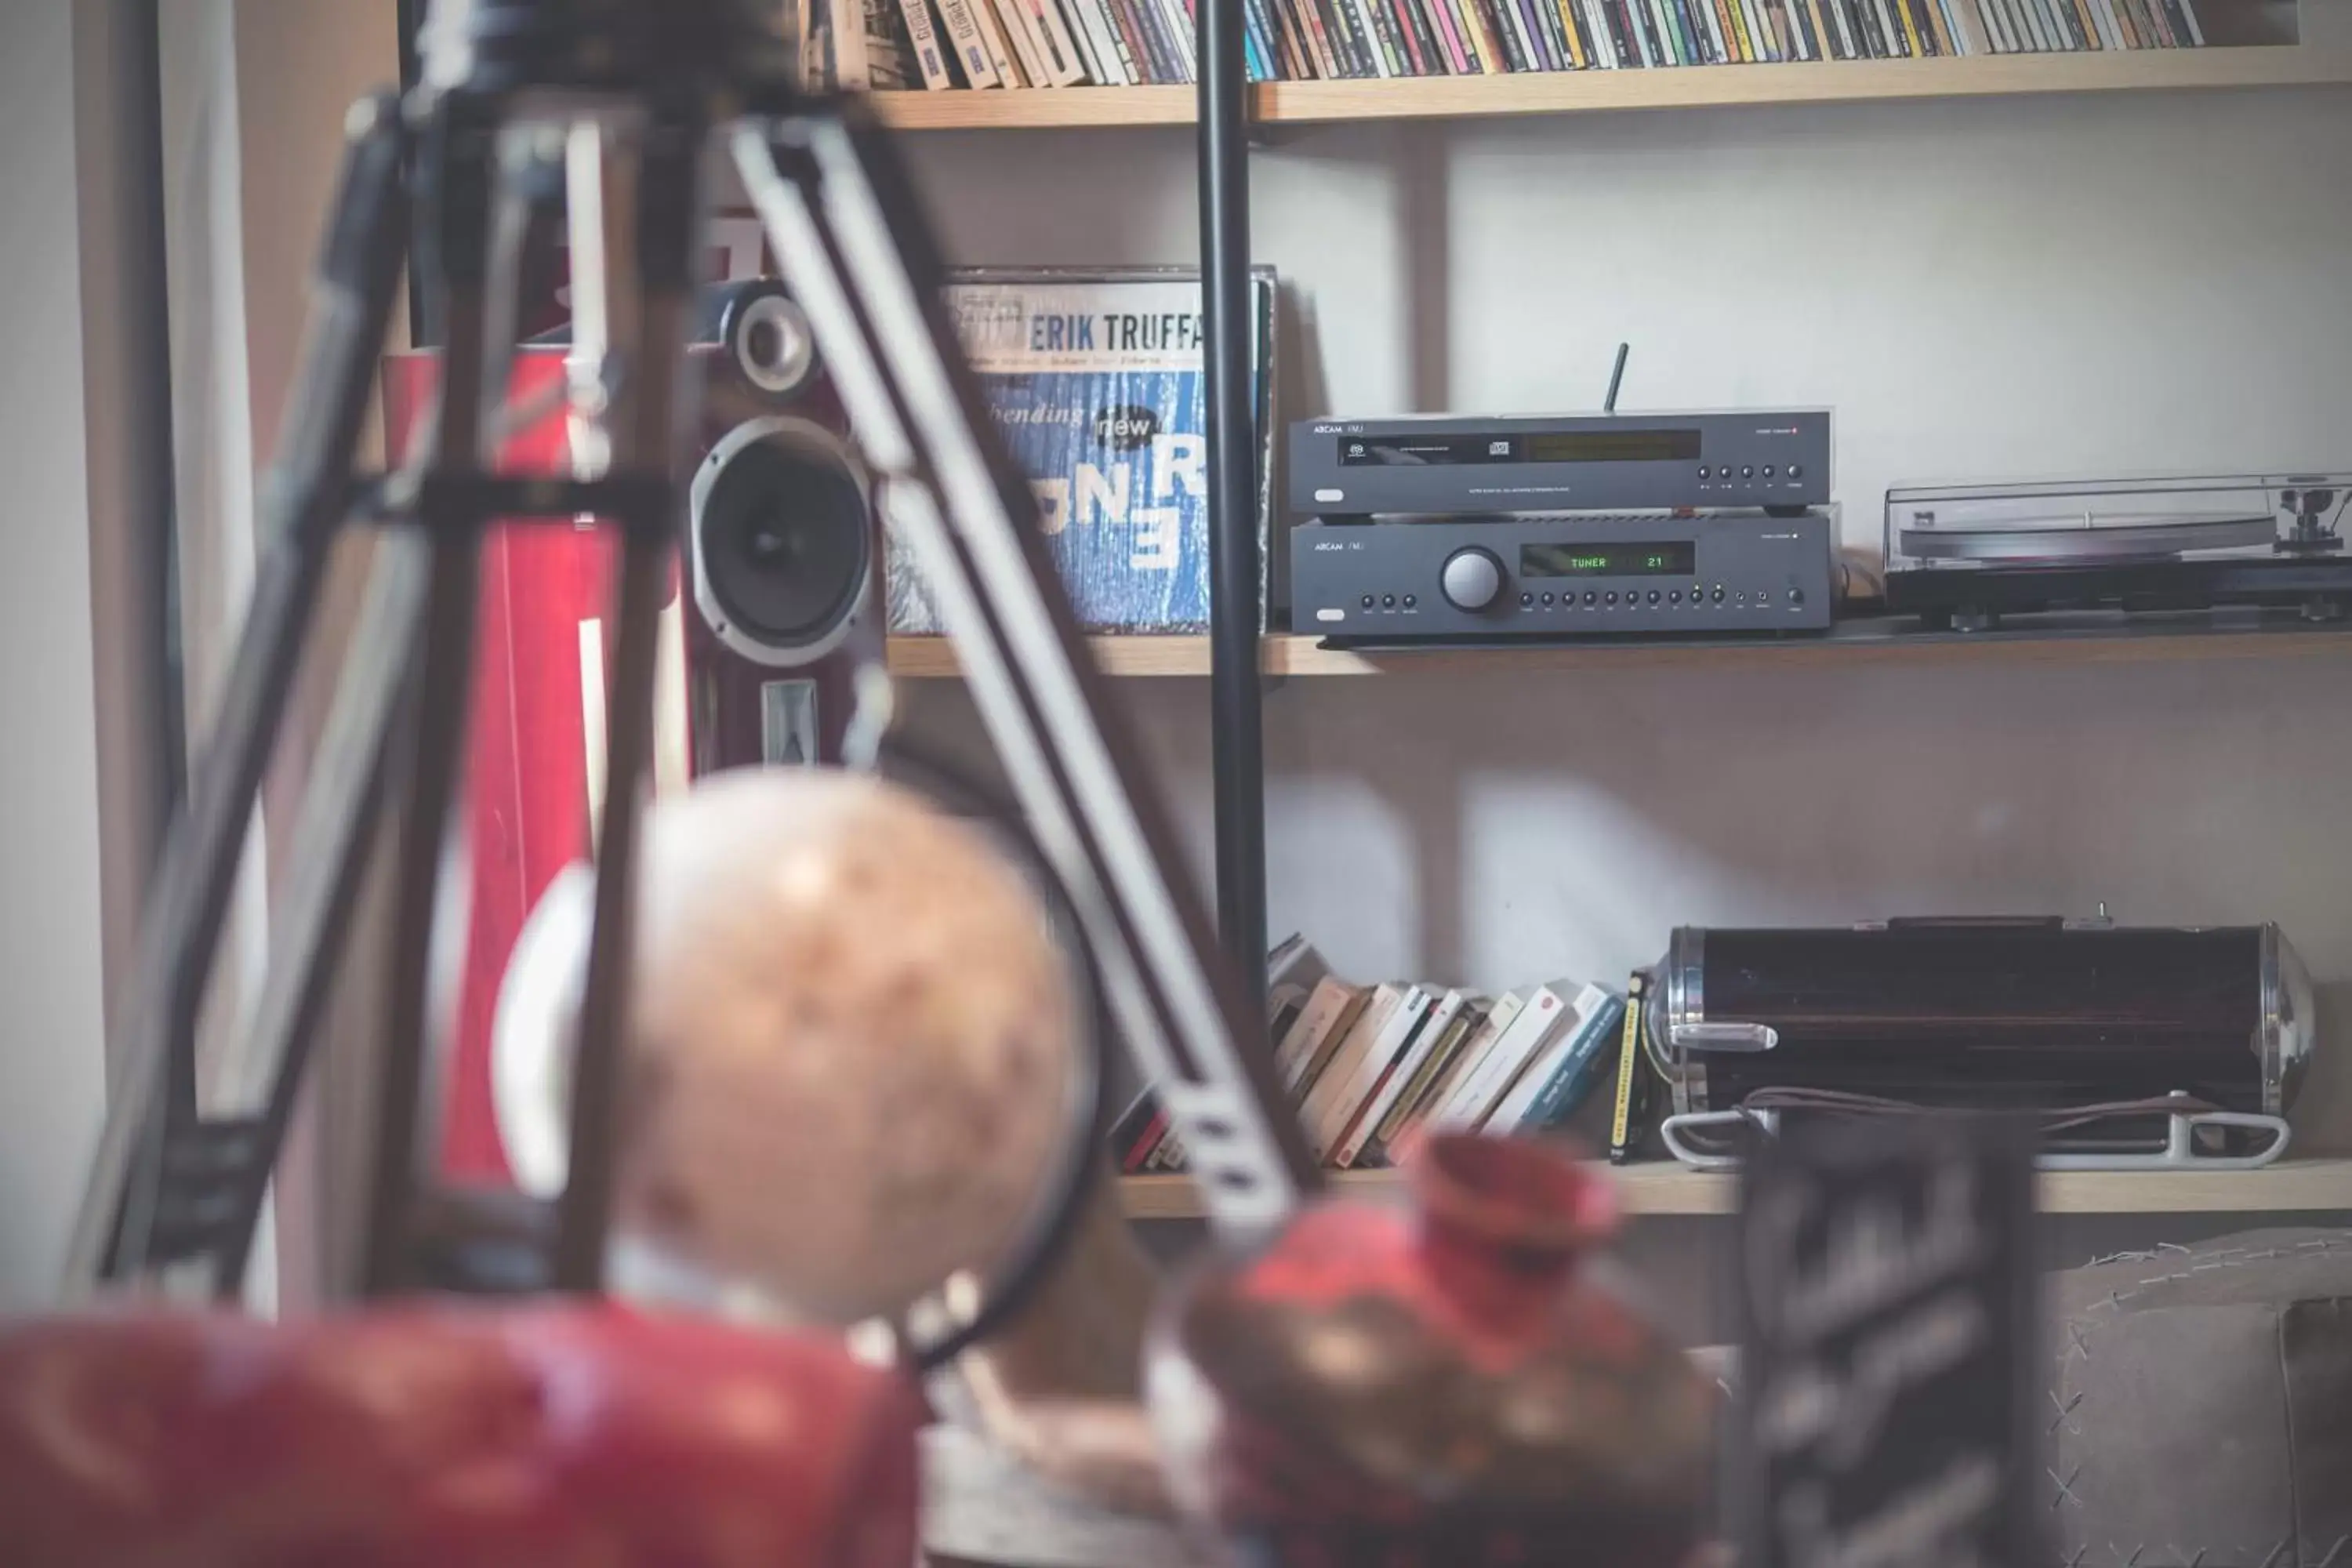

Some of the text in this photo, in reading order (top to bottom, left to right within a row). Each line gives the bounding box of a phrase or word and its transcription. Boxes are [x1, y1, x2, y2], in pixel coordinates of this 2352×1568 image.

[1029, 314, 1094, 351] ERIK
[991, 402, 1083, 427] bending
[1098, 419, 1150, 436] new
[1571, 556, 1661, 568] TUNER 21
